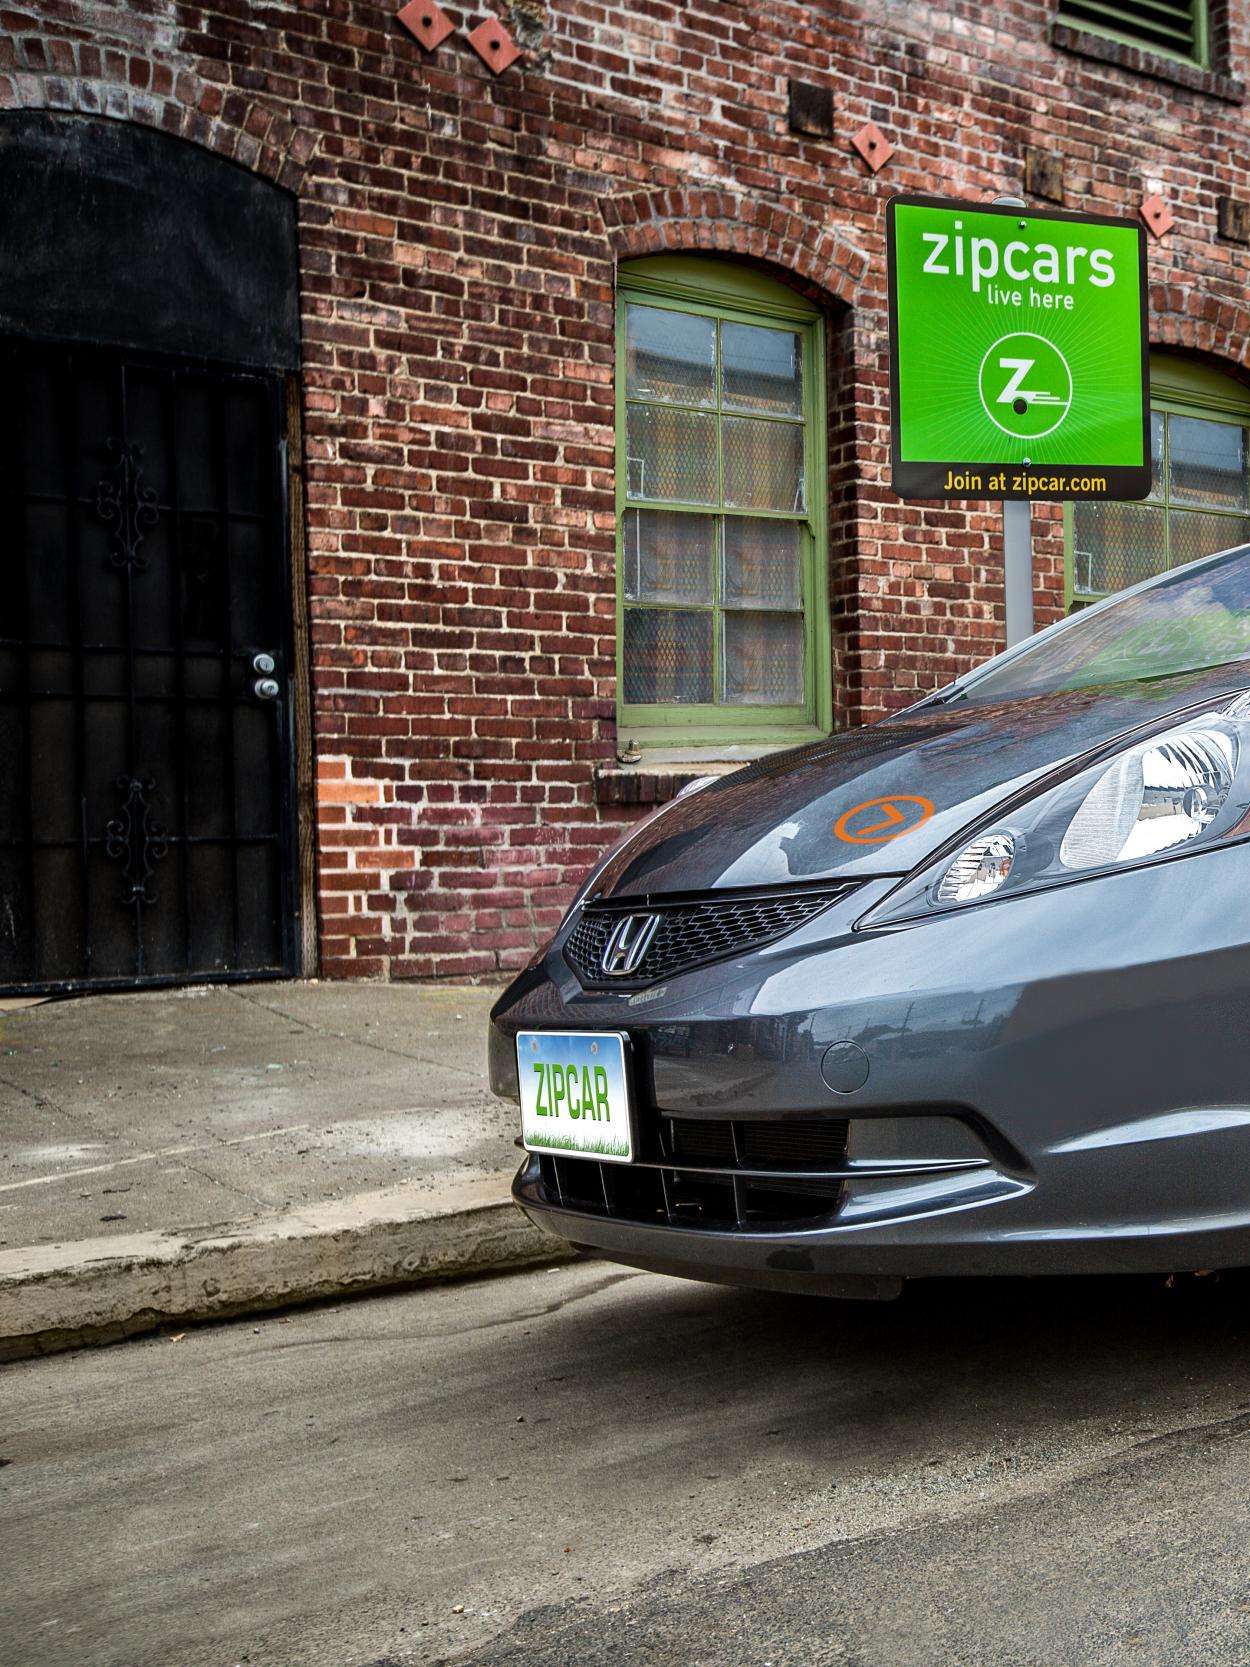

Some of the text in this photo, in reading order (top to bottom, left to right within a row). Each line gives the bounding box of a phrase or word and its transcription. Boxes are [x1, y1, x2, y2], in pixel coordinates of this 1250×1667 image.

[921, 220, 1116, 293] zipcars
[987, 283, 1075, 311] live here
[943, 470, 1108, 495] Join at zipcar.com
[533, 1063, 611, 1122] ZIPCAR
